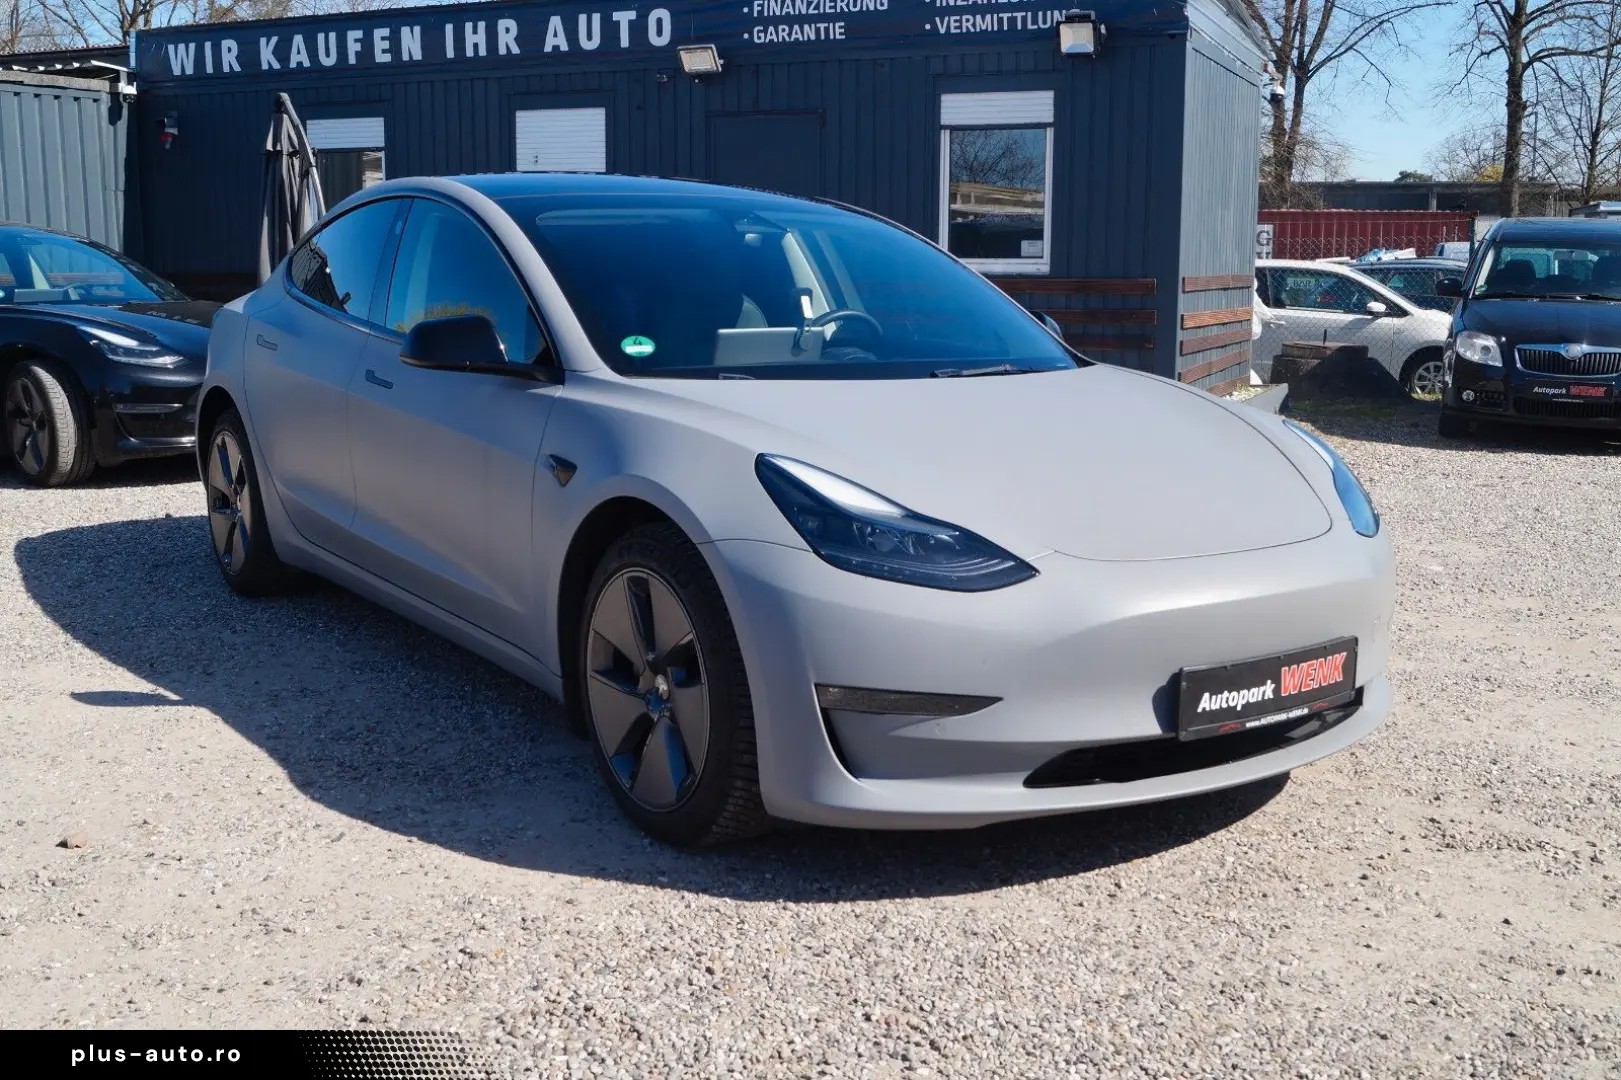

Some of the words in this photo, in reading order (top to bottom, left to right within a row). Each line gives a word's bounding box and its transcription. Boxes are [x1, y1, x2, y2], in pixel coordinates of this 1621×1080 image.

[753, 0, 888, 17] FINANZIERUNG
[753, 22, 846, 43] GARANTIE
[935, 9, 1081, 34] VERMITTLUN
[168, 39, 241, 76] WIR
[259, 26, 422, 70] KAUFEN
[445, 18, 520, 59] IHR
[543, 8, 671, 53] AUTO
[1532, 386, 1567, 395] Autopark
[1197, 680, 1276, 713] Autopark
[1281, 652, 1347, 696] WENK
